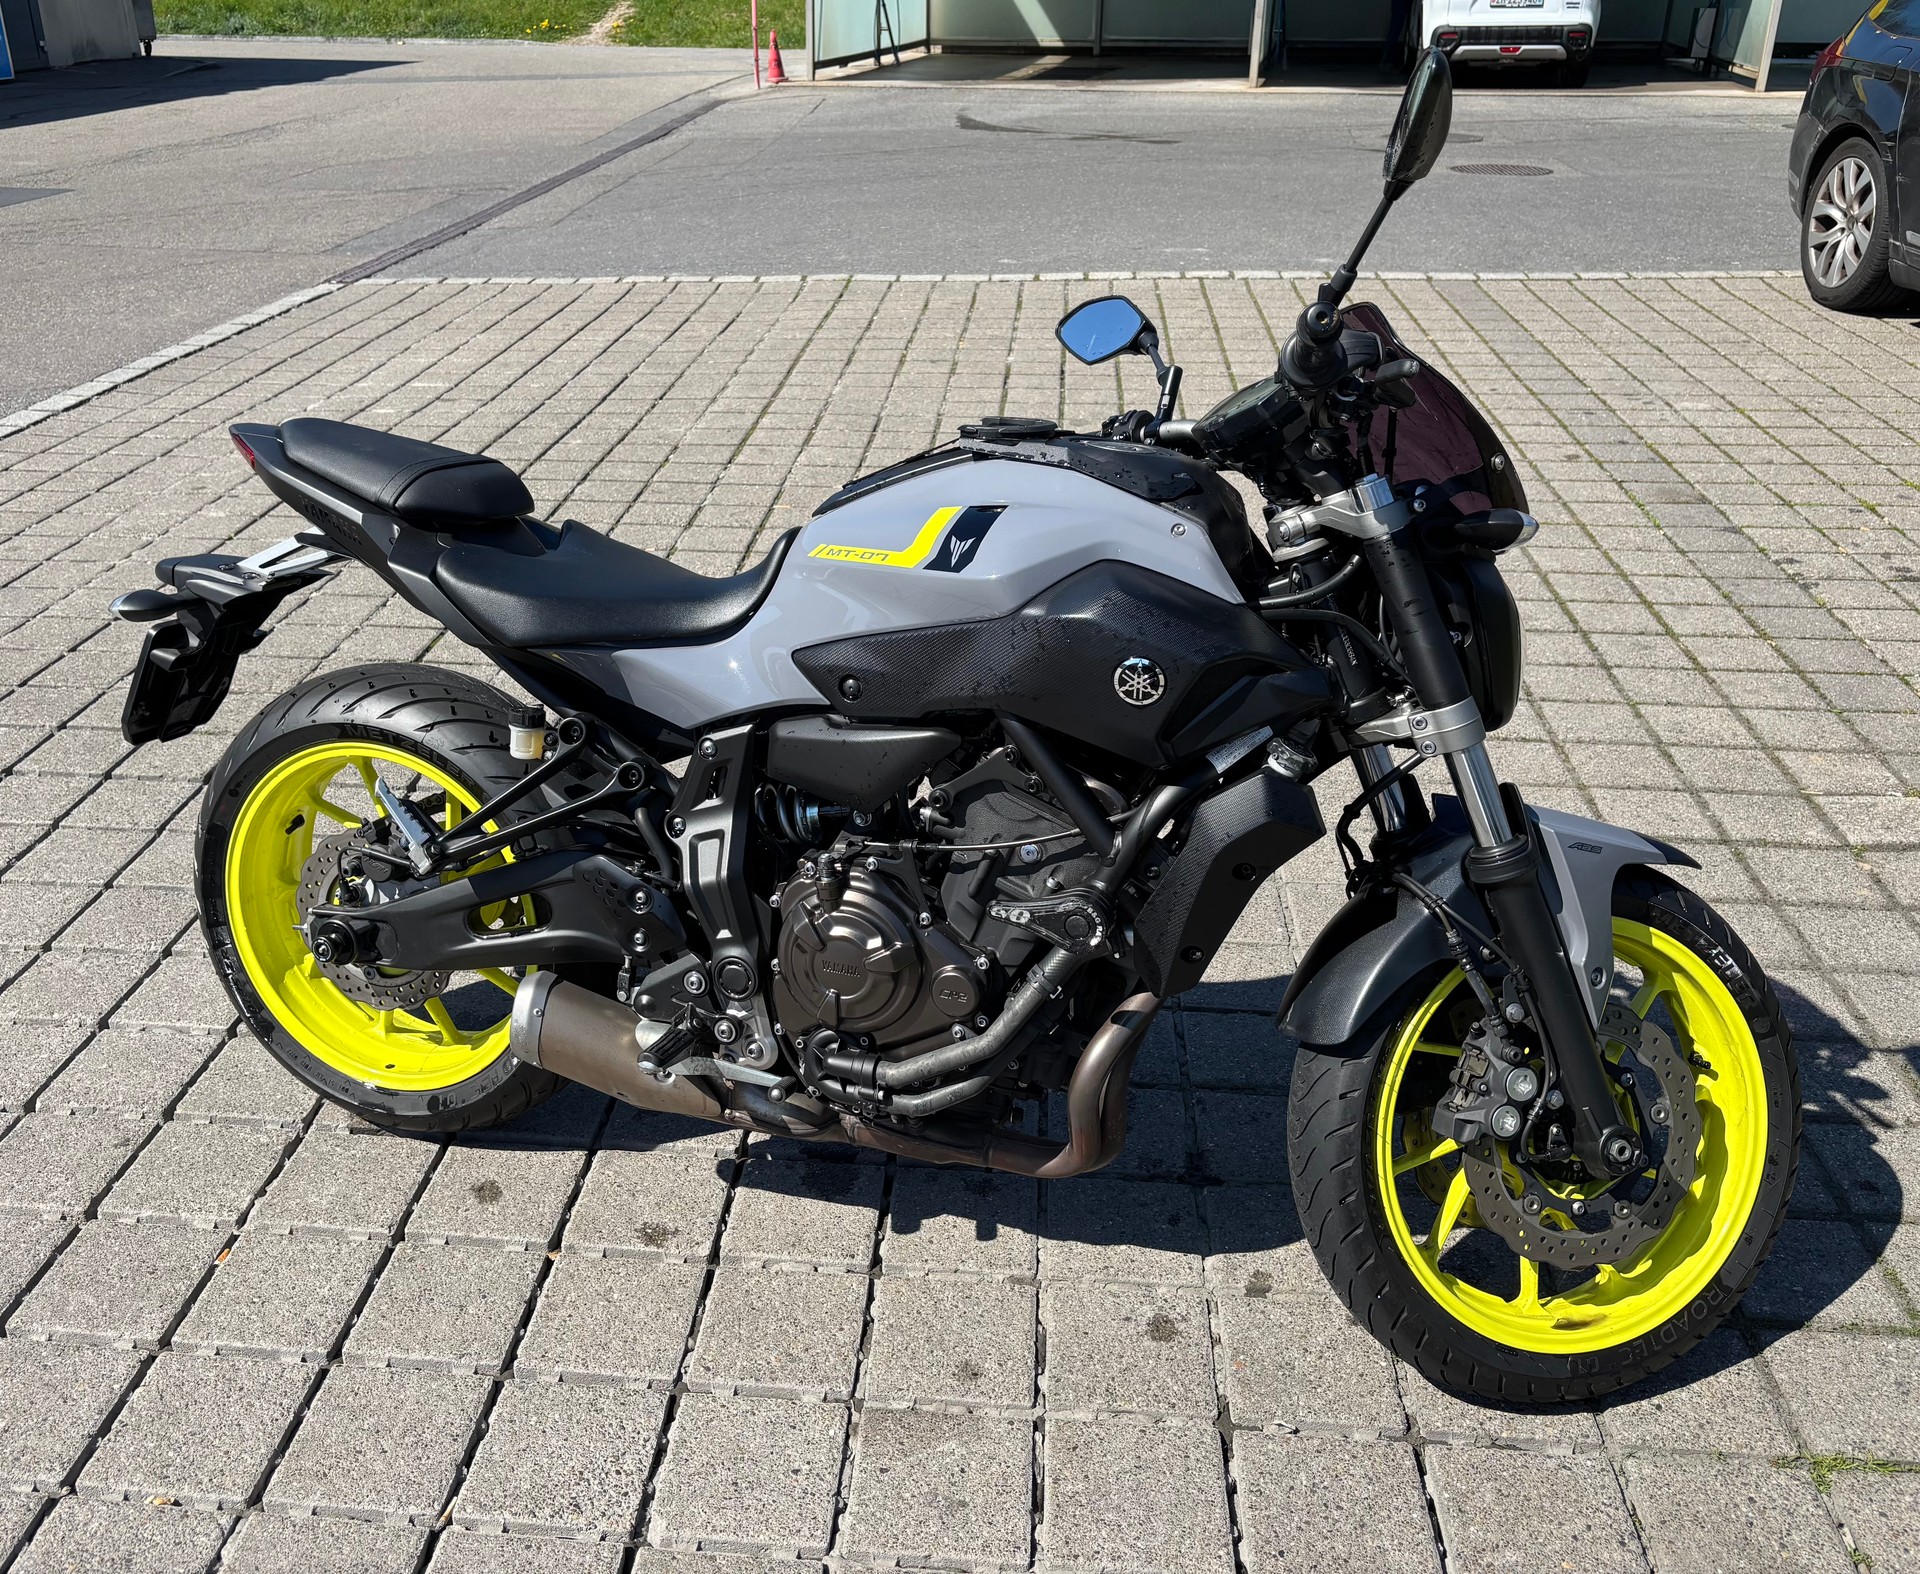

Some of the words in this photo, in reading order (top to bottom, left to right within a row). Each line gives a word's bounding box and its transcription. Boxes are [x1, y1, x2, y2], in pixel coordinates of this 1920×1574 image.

[826, 548, 889, 562] MT-07
[344, 724, 476, 787] METZELER
[1568, 842, 1603, 854] ABS
[822, 959, 861, 978] YAMAHA
[1621, 1284, 1726, 1366] ROADTEC
